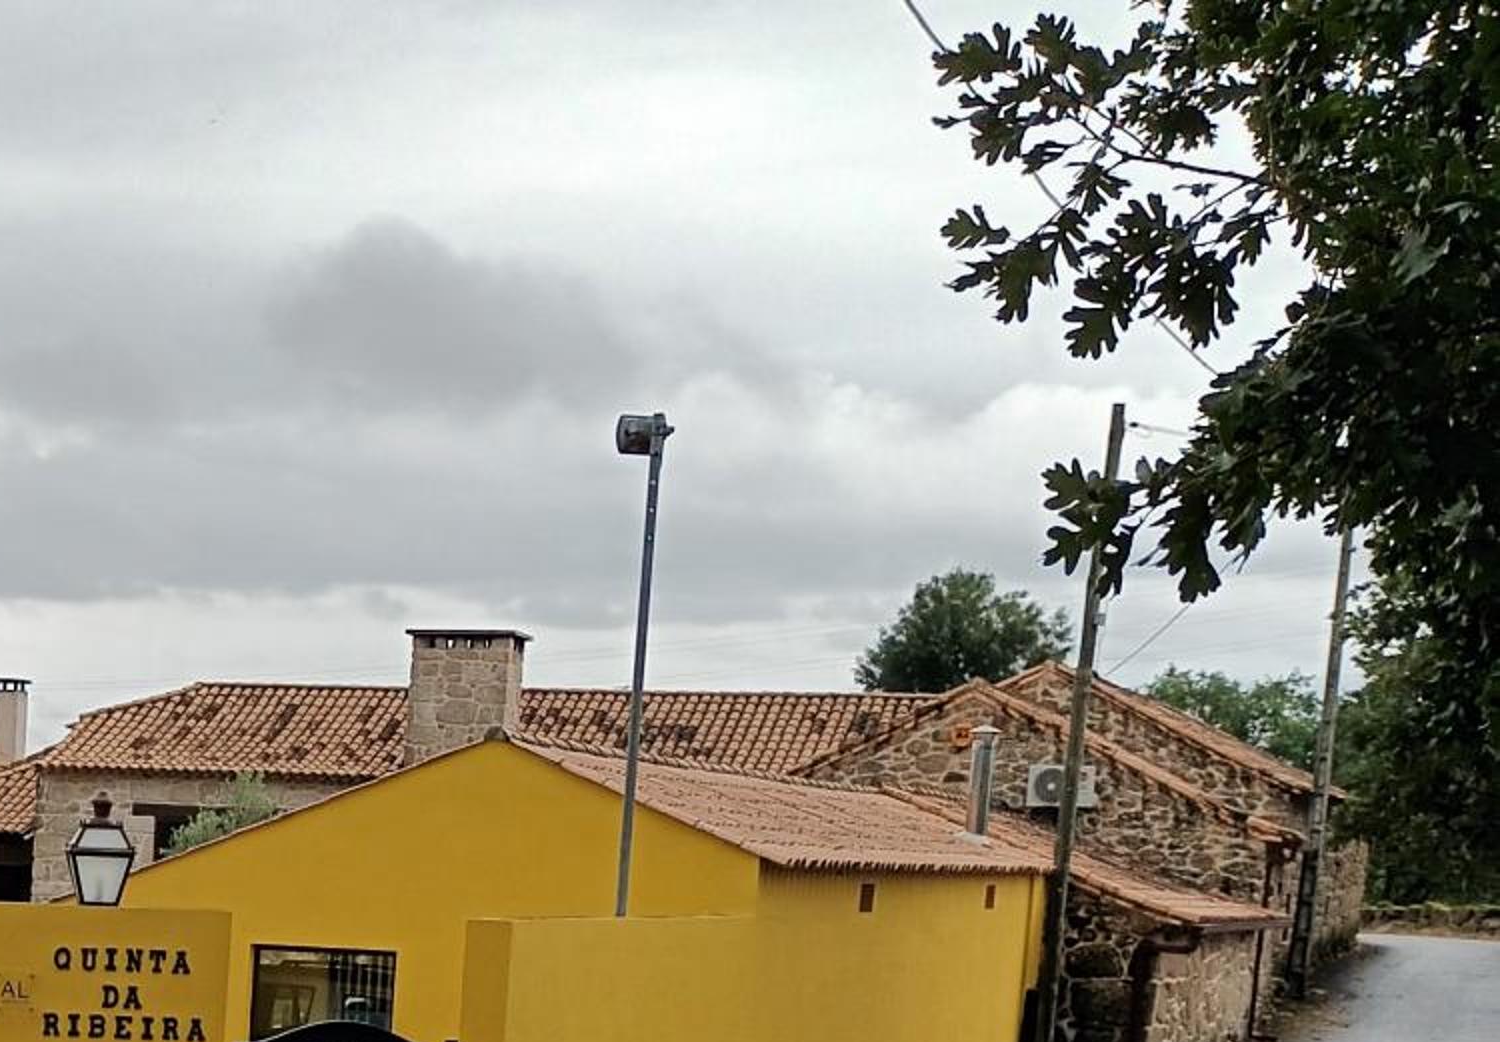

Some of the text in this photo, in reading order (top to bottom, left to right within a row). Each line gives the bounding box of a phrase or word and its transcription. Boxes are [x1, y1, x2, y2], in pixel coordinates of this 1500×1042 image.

[53, 947, 191, 975] QUINTA
[1, 980, 30, 998] AL
[101, 985, 142, 1010] DA
[43, 1012, 206, 1042] RIBEIRA
